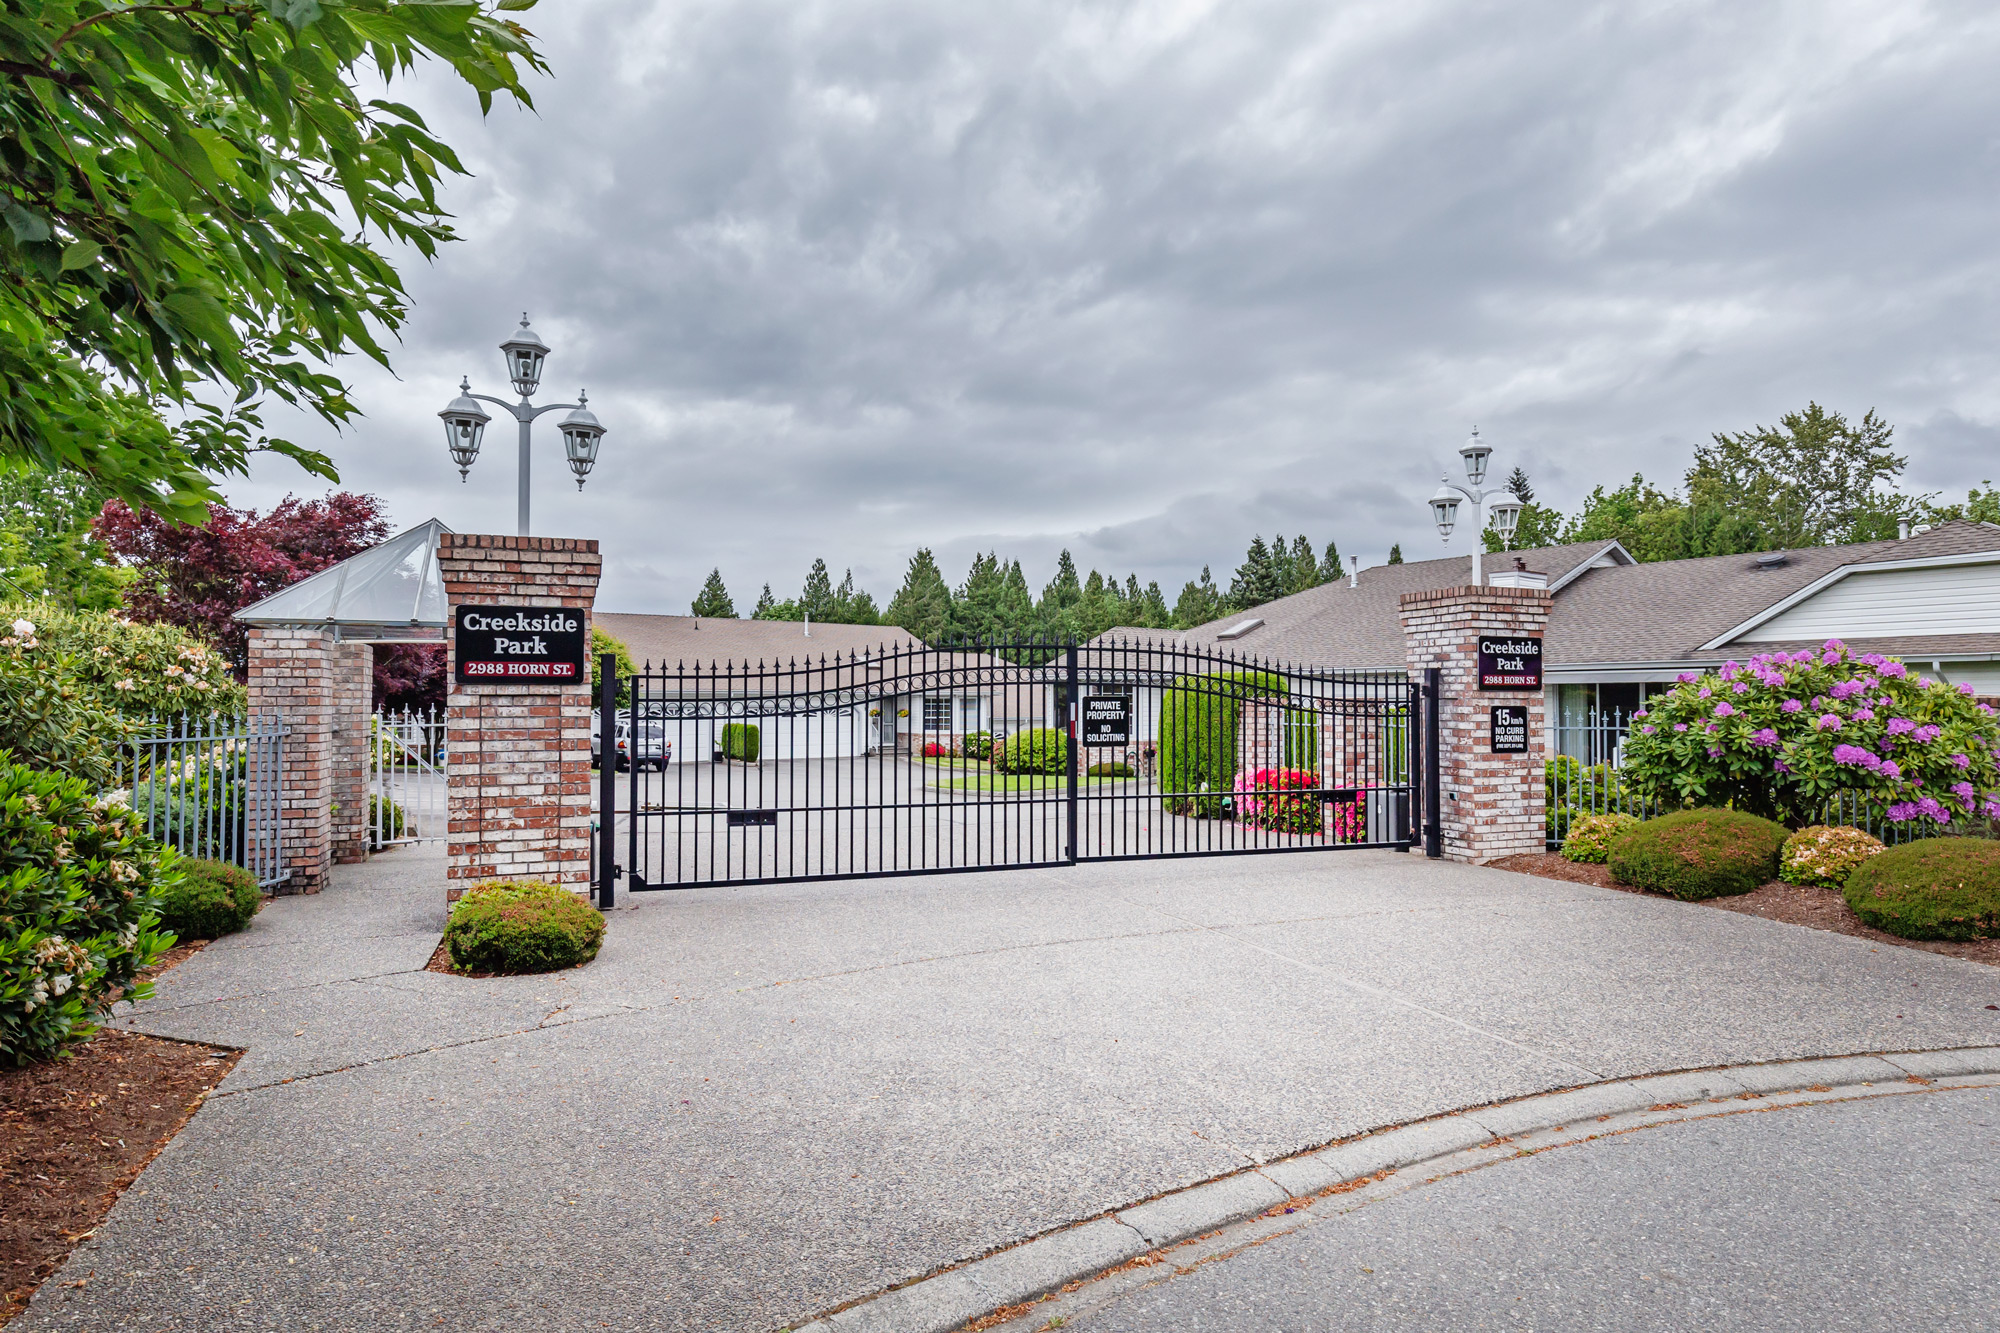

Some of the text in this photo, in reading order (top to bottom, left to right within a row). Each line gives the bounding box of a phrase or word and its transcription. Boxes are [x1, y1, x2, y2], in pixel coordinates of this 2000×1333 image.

[464, 613, 578, 632] Creekside
[494, 636, 548, 654] Park
[1482, 641, 1538, 654] Creekside
[468, 663, 572, 675] 2988 HORN ST.
[1497, 657, 1524, 670] Park
[1484, 676, 1502, 684] 2988
[1090, 702, 1120, 710] PRIVATE
[1086, 711, 1125, 720] PROPERTY
[1496, 709, 1510, 726] 15
[1086, 734, 1125, 742] SOLICITING
